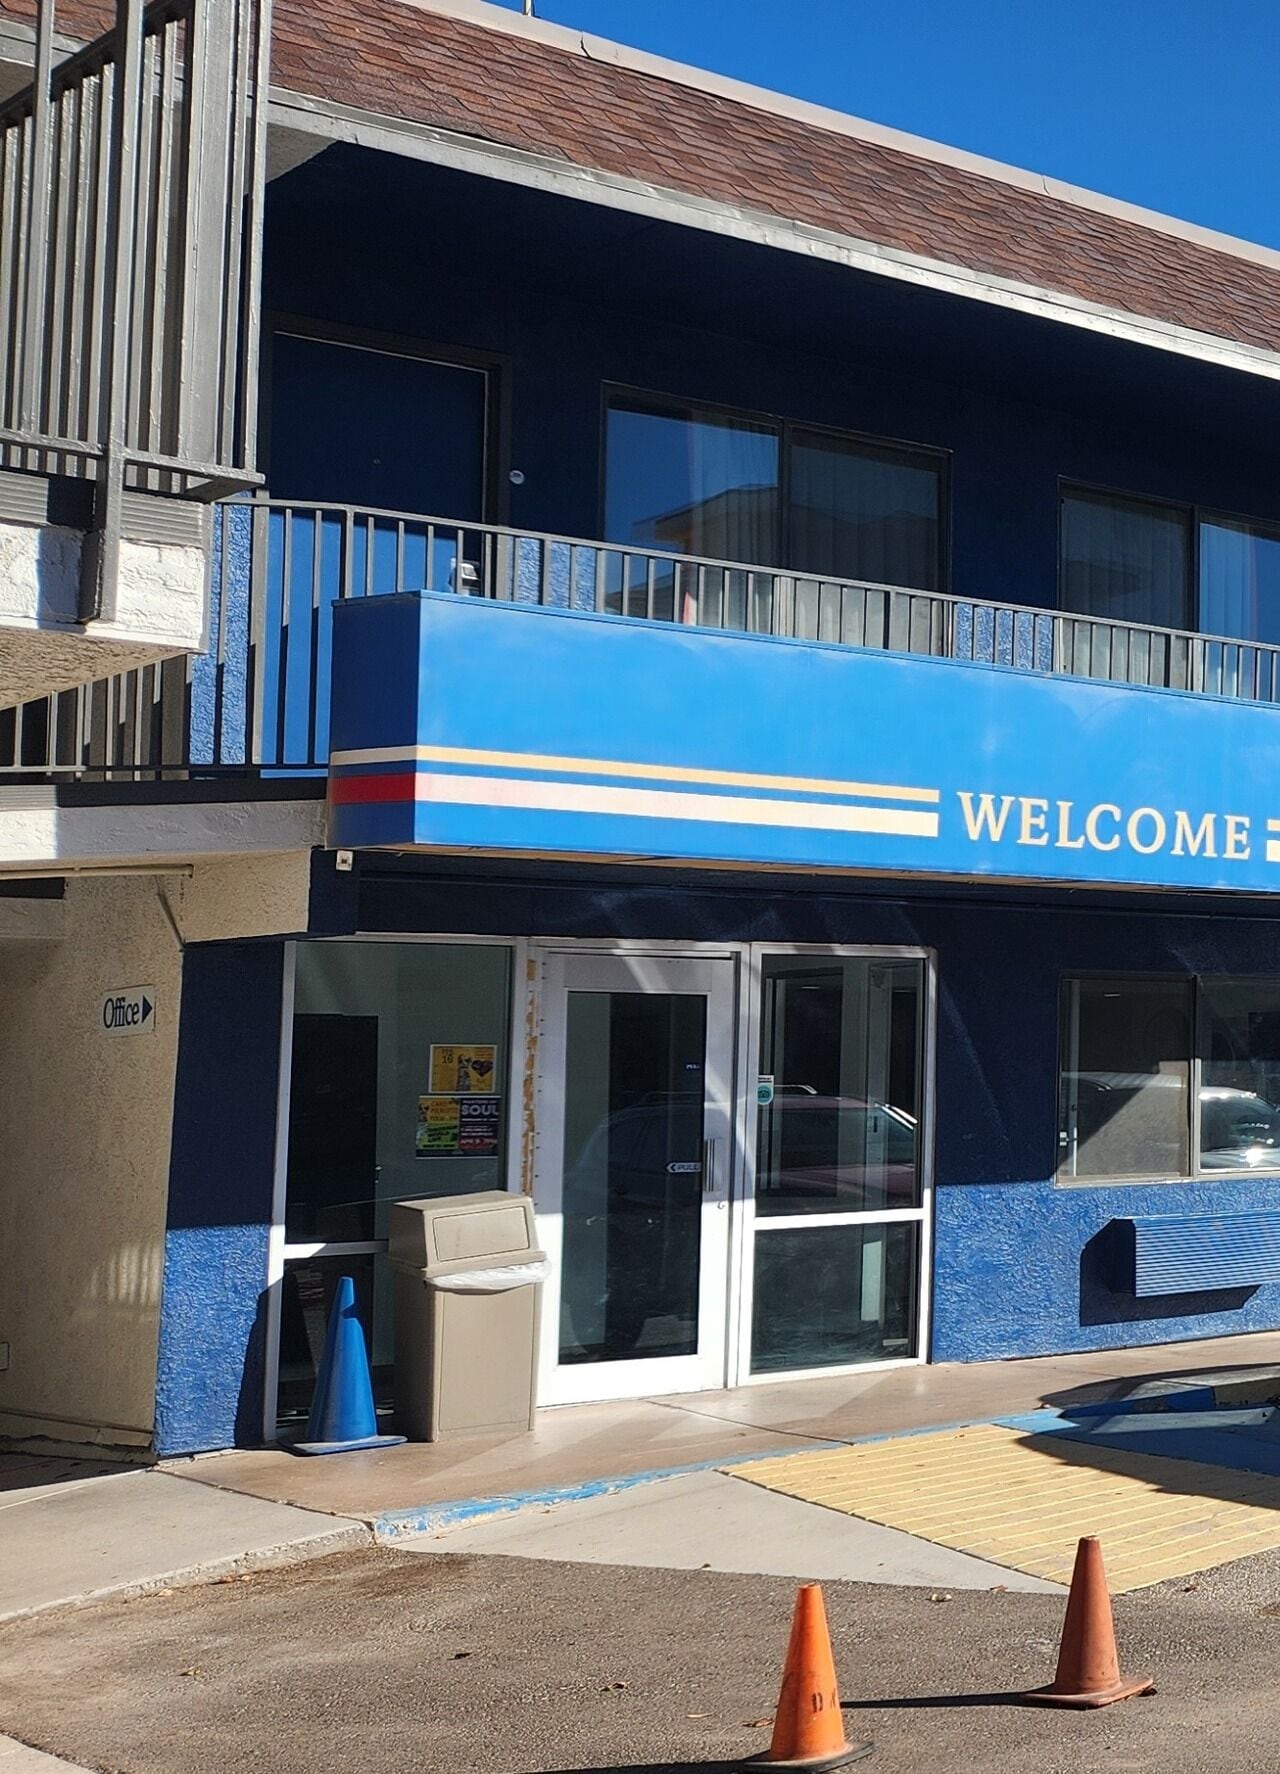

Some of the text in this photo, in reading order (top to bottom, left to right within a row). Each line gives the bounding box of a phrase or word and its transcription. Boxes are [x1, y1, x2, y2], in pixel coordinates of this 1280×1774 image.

[956, 791, 1250, 860] WELCOME
[103, 996, 139, 1029] Office
[461, 1104, 499, 1115] SOUL
[676, 1163, 700, 1171] PULL
